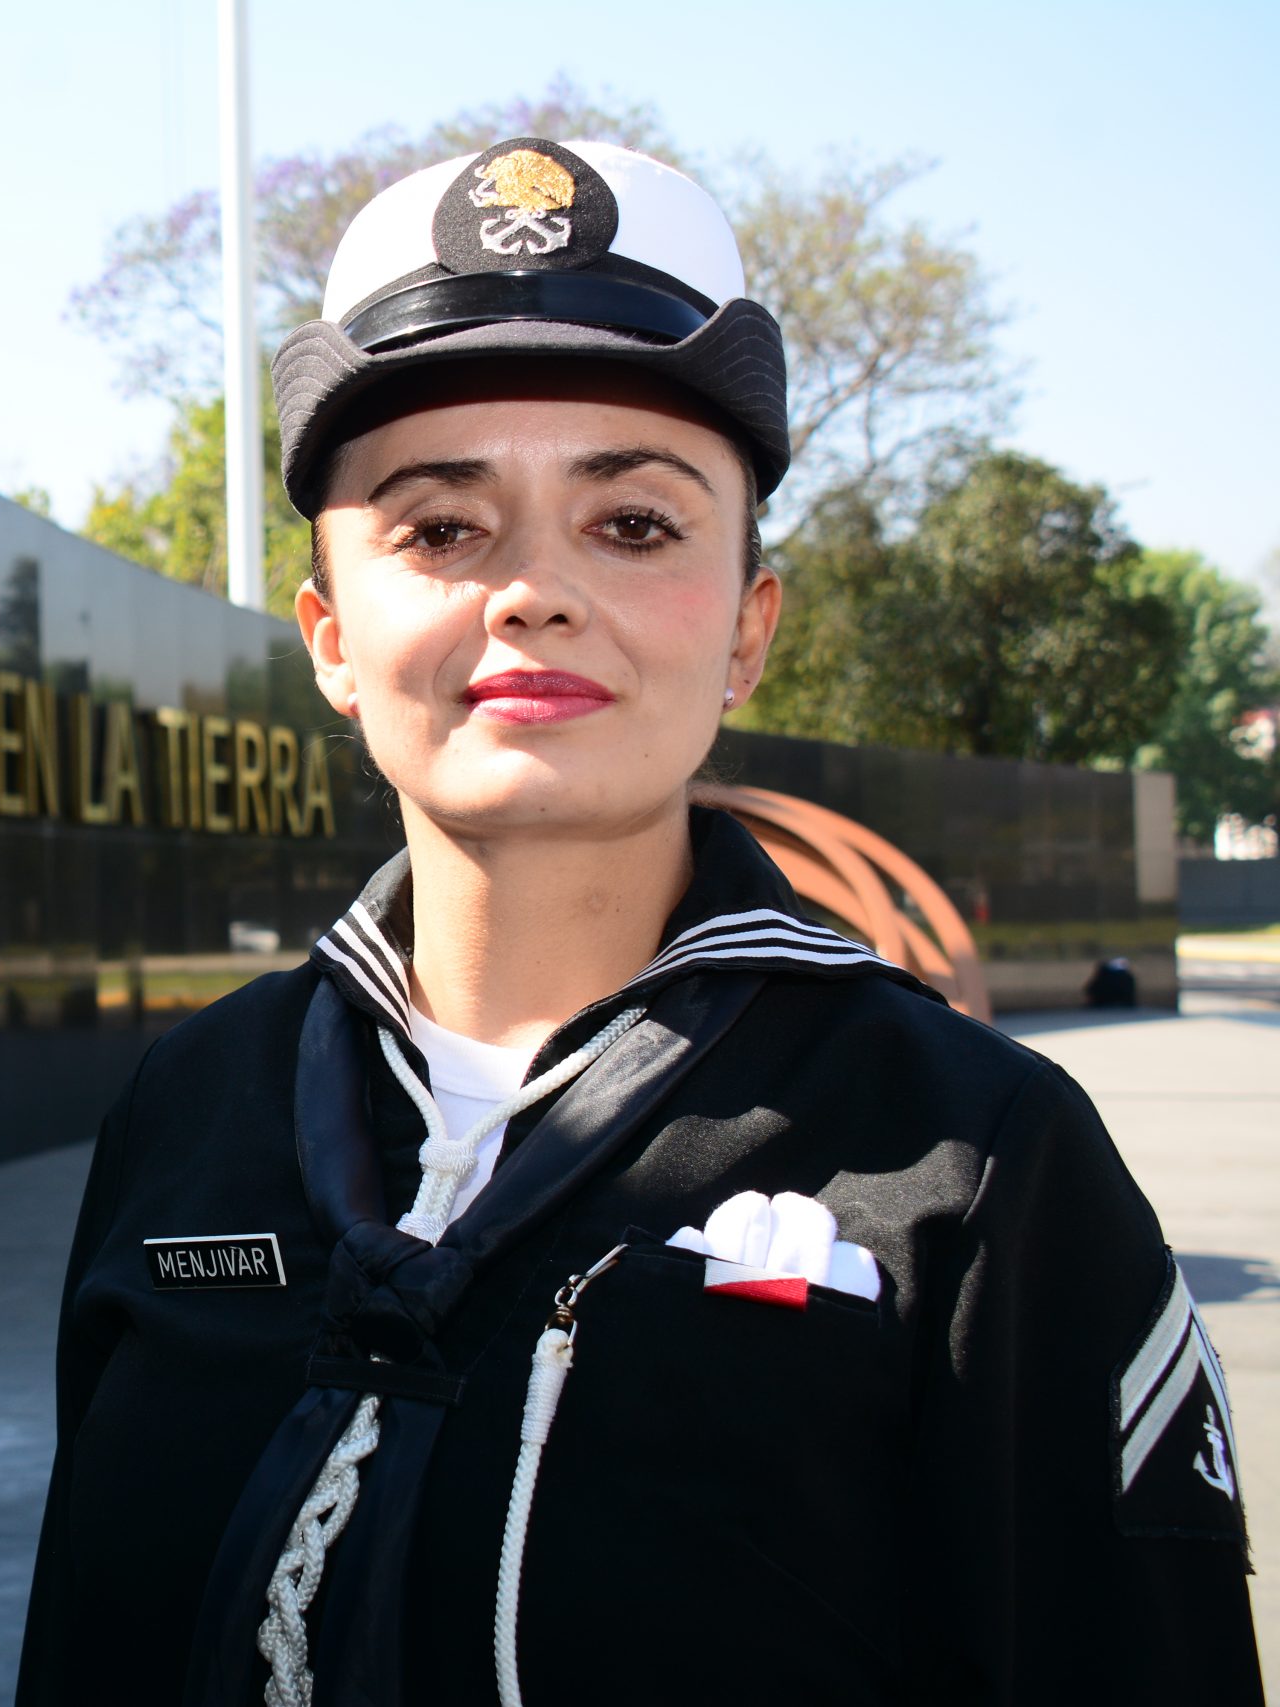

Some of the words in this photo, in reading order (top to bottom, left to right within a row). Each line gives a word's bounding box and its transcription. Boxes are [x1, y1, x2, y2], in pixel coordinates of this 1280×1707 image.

[76, 693, 144, 827] LA
[156, 705, 335, 839] TIERRA
[157, 1247, 269, 1278] MENJIVAR
